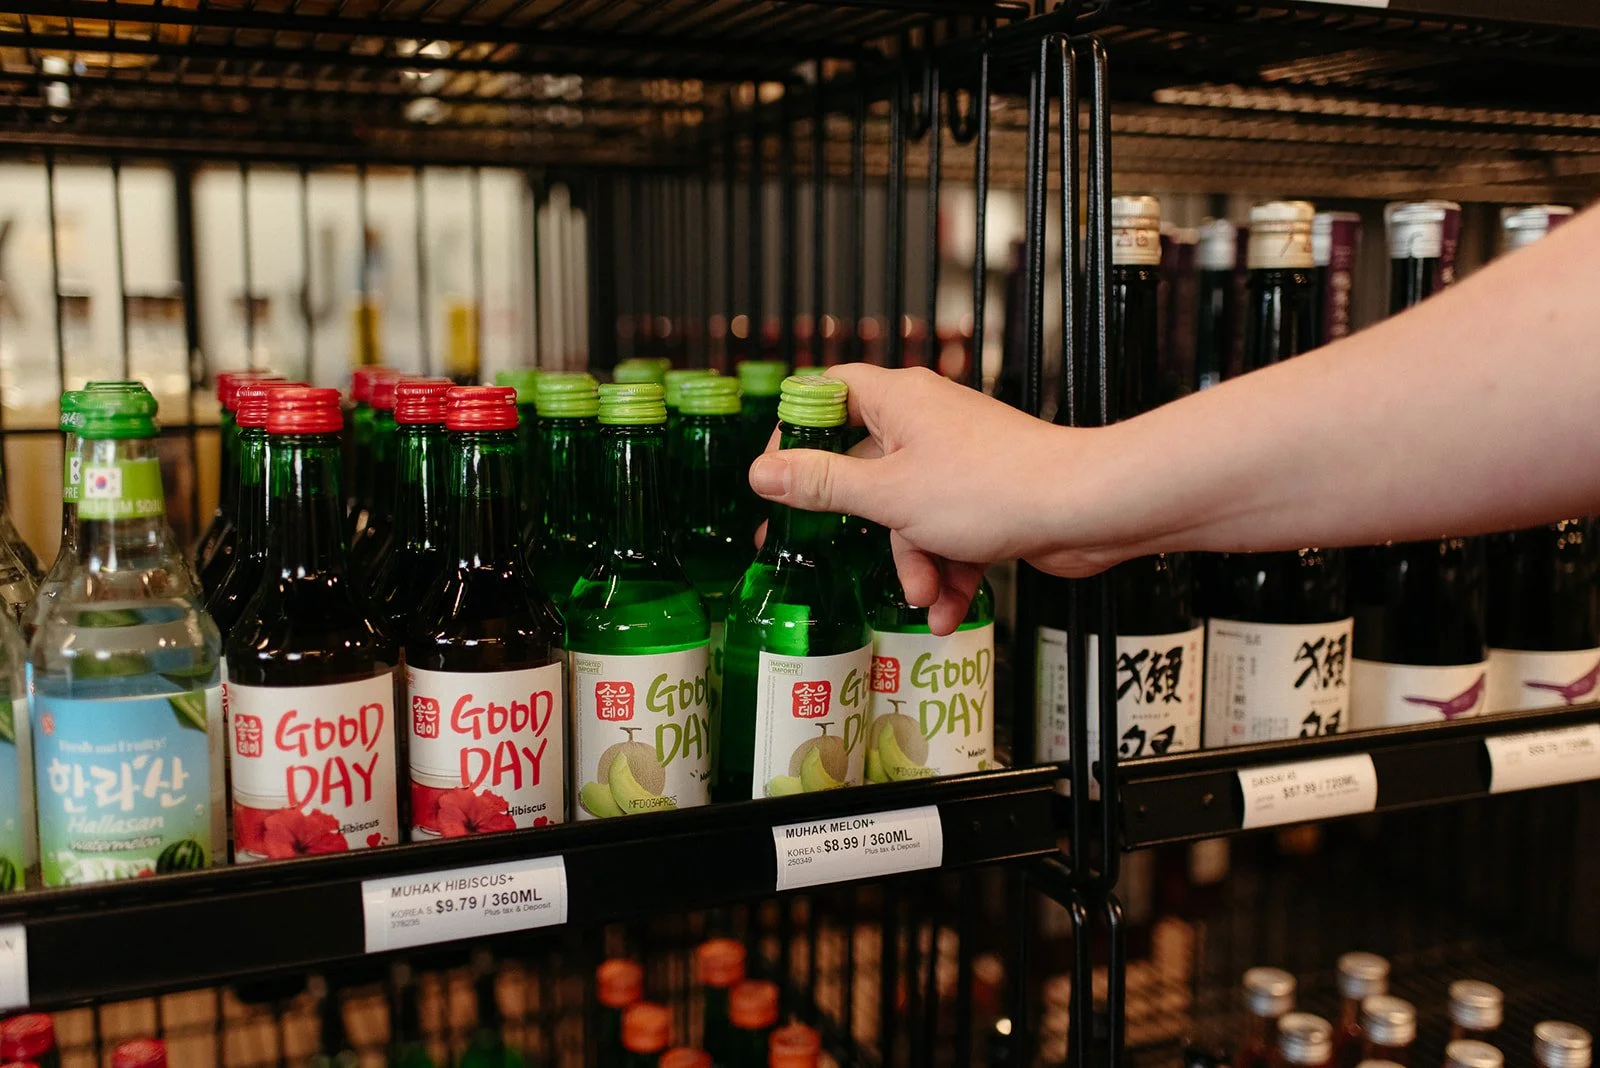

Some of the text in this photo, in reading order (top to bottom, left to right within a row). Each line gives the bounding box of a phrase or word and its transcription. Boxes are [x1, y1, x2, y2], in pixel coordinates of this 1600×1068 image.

[910, 648, 990, 693] GOOD
[597, 683, 631, 706] 좋은
[794, 683, 828, 704] 좋은
[413, 698, 437, 722] 좋은
[450, 690, 553, 740] GOOD
[601, 706, 629, 719] 데이
[798, 704, 825, 716] 데이
[919, 690, 987, 741] DAY
[275, 703, 384, 758] GOOD
[416, 722, 436, 736] 데이
[460, 737, 548, 791] DAY
[47, 755, 190, 813] 한라산
[286, 752, 379, 809] DAY
[507, 802, 547, 816] Hibiscus
[338, 819, 380, 834] Hibiscus
[786, 819, 875, 838] MUHAK MELON+
[787, 847, 815, 857] KOREA
[824, 836, 859, 854] $8.99
[870, 829, 913, 846] 360ML
[865, 847, 879, 855] Plus
[897, 842, 921, 852] Deposit
[787, 857, 813, 866] 250349
[391, 874, 515, 898] MUHAK HIBISCUS+
[391, 908, 424, 919] KOREA
[436, 896, 477, 914] $9.79
[482, 894, 488, 908] /
[492, 888, 542, 906] 360ML
[484, 902, 552, 917] Plus tax & Deposit
